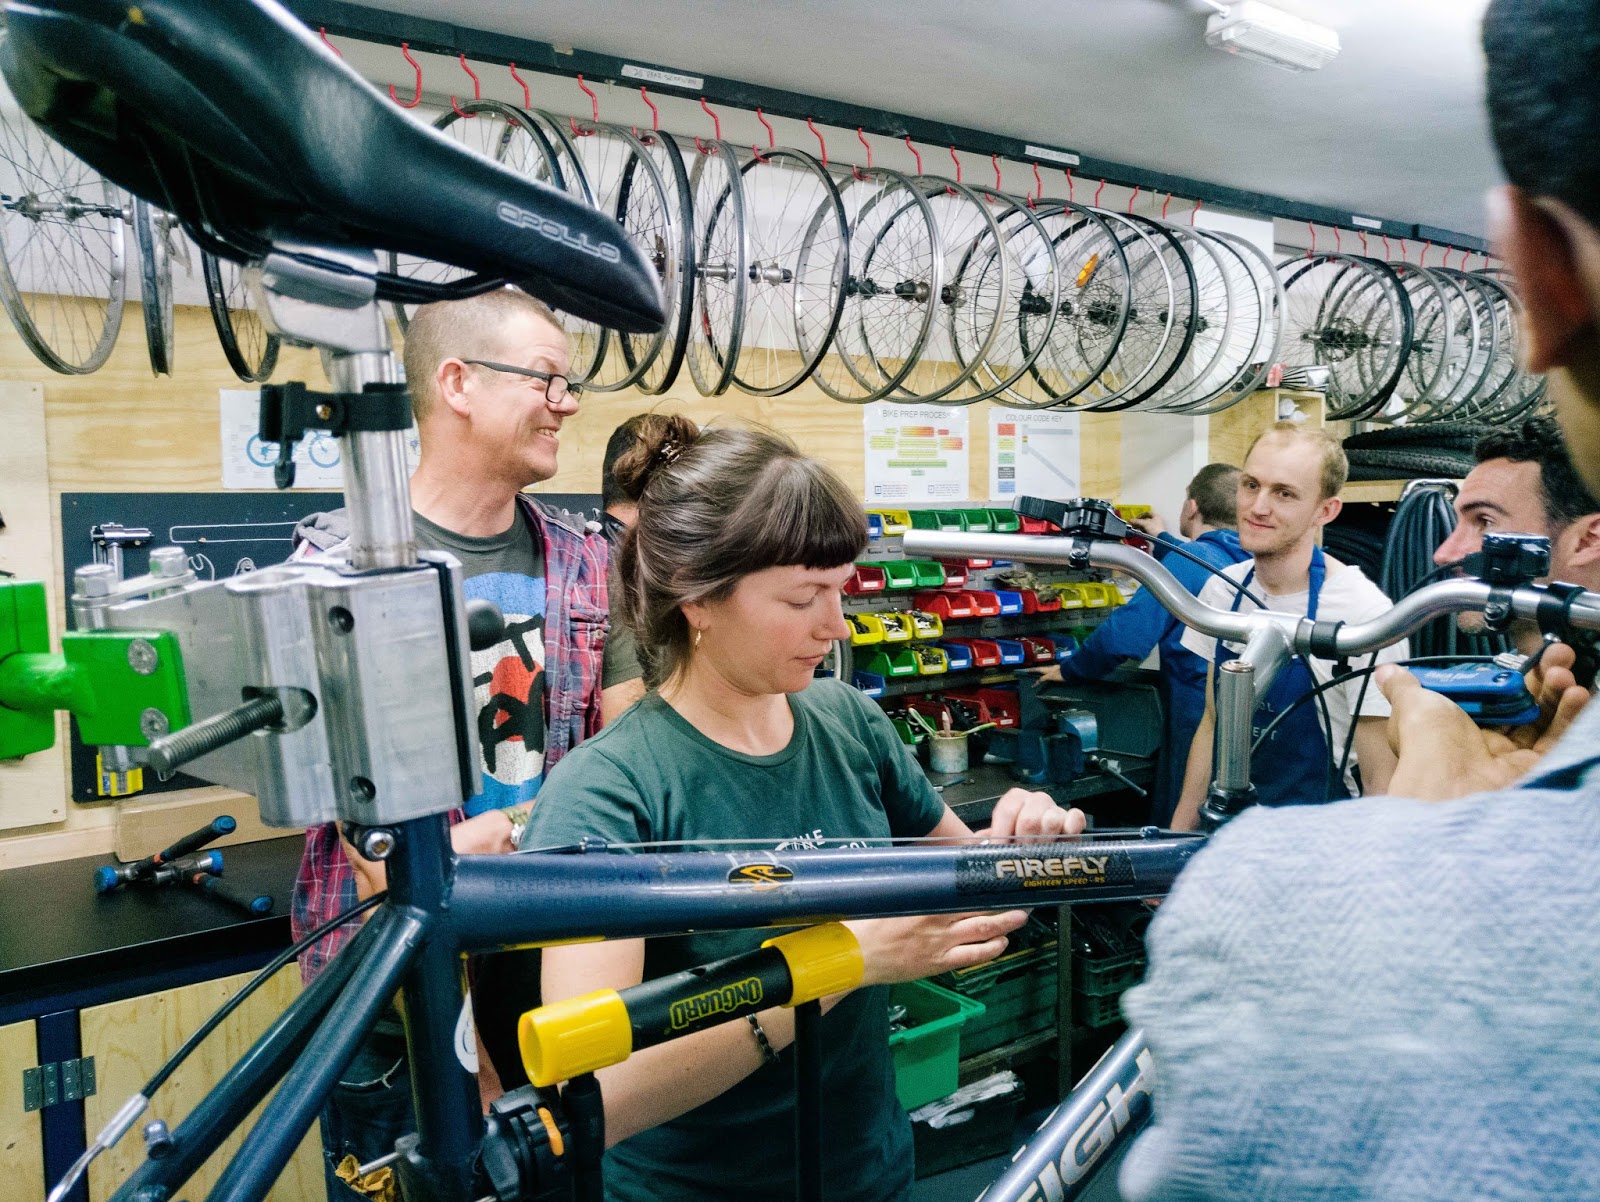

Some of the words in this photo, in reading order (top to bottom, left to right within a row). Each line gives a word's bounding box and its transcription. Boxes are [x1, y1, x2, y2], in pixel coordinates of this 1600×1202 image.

[497, 201, 620, 263] APOLLO
[882, 409, 898, 418] BIKE
[900, 410, 918, 418] PREP
[1005, 413, 1032, 422] COLOUR
[1033, 414, 1050, 422] CODE
[995, 857, 1109, 878] FIREFLY
[1023, 879, 1061, 888] EIGHTEEN
[1063, 877, 1088, 885] SPEED
